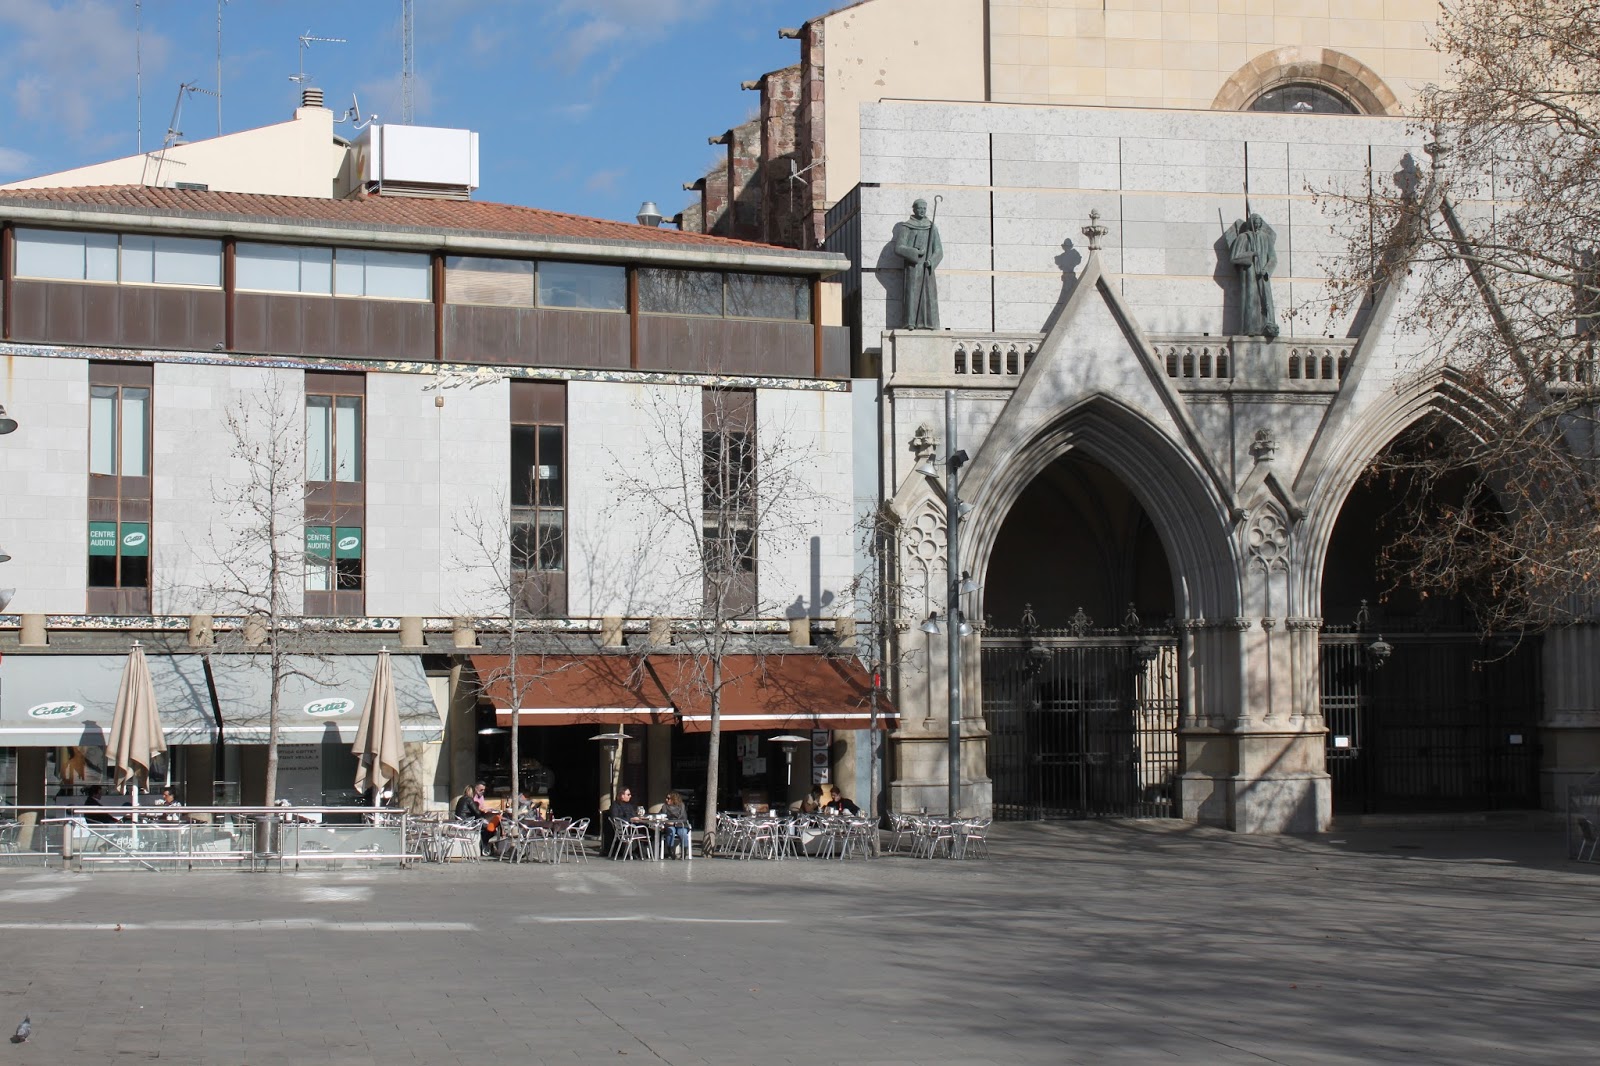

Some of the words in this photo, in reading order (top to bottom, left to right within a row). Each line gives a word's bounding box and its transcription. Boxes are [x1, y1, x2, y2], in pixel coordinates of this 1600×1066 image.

[90, 530, 115, 538] CENTRE
[90, 539, 115, 547] AUDITIU
[32, 705, 77, 716] Cottet
[308, 701, 348, 713] Cottet
